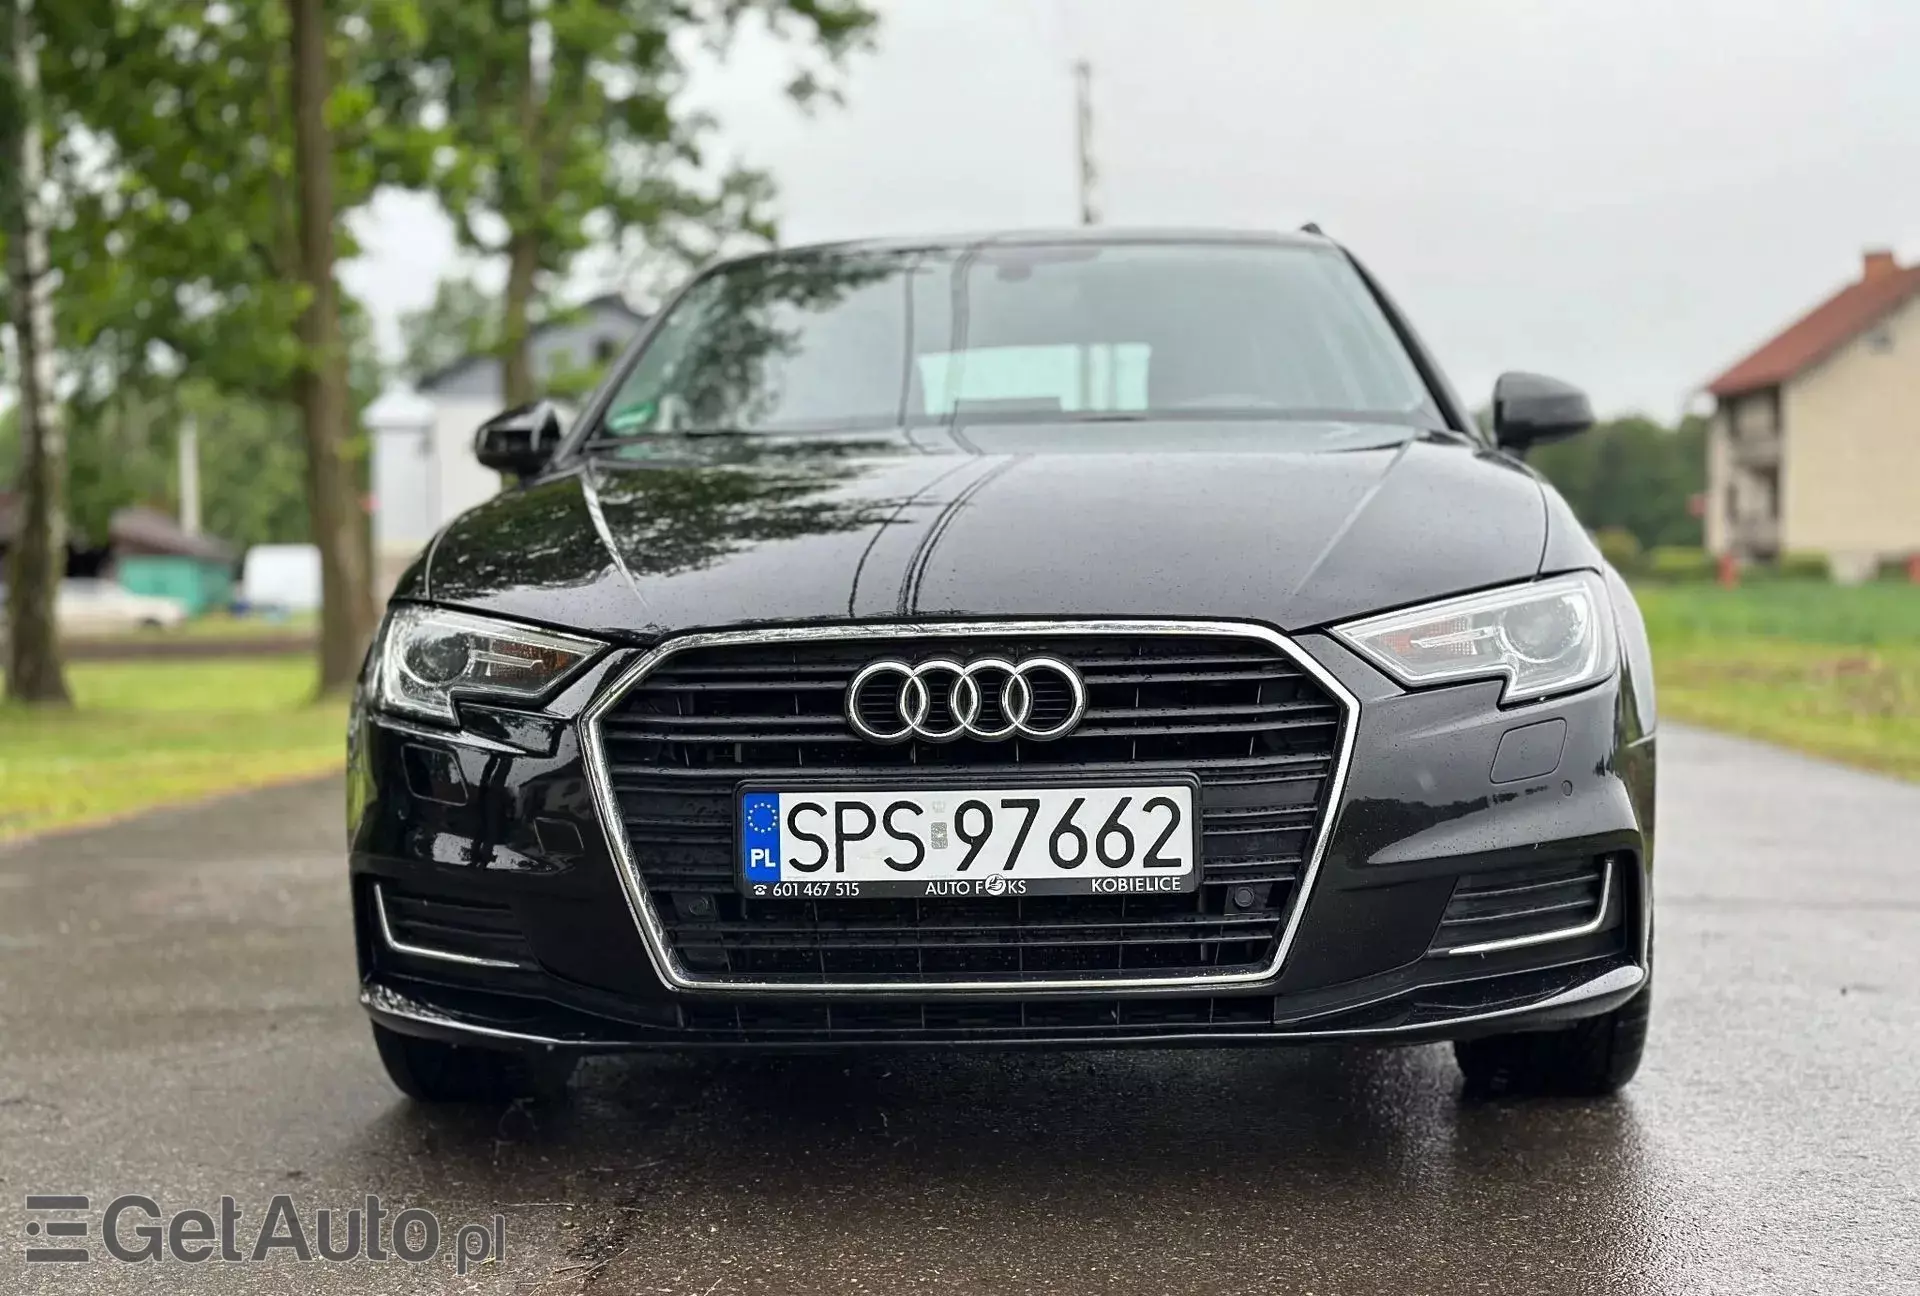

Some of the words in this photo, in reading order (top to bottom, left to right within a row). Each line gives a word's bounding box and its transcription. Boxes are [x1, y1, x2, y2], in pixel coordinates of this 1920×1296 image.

[787, 800, 925, 873] SPS
[954, 796, 1182, 871] 97662
[750, 848, 776, 868] PL
[772, 882, 798, 897] 601
[803, 882, 828, 897] 467
[835, 882, 860, 896] 515
[925, 880, 970, 895] AUTO
[1091, 876, 1181, 893] KOBIELICE
